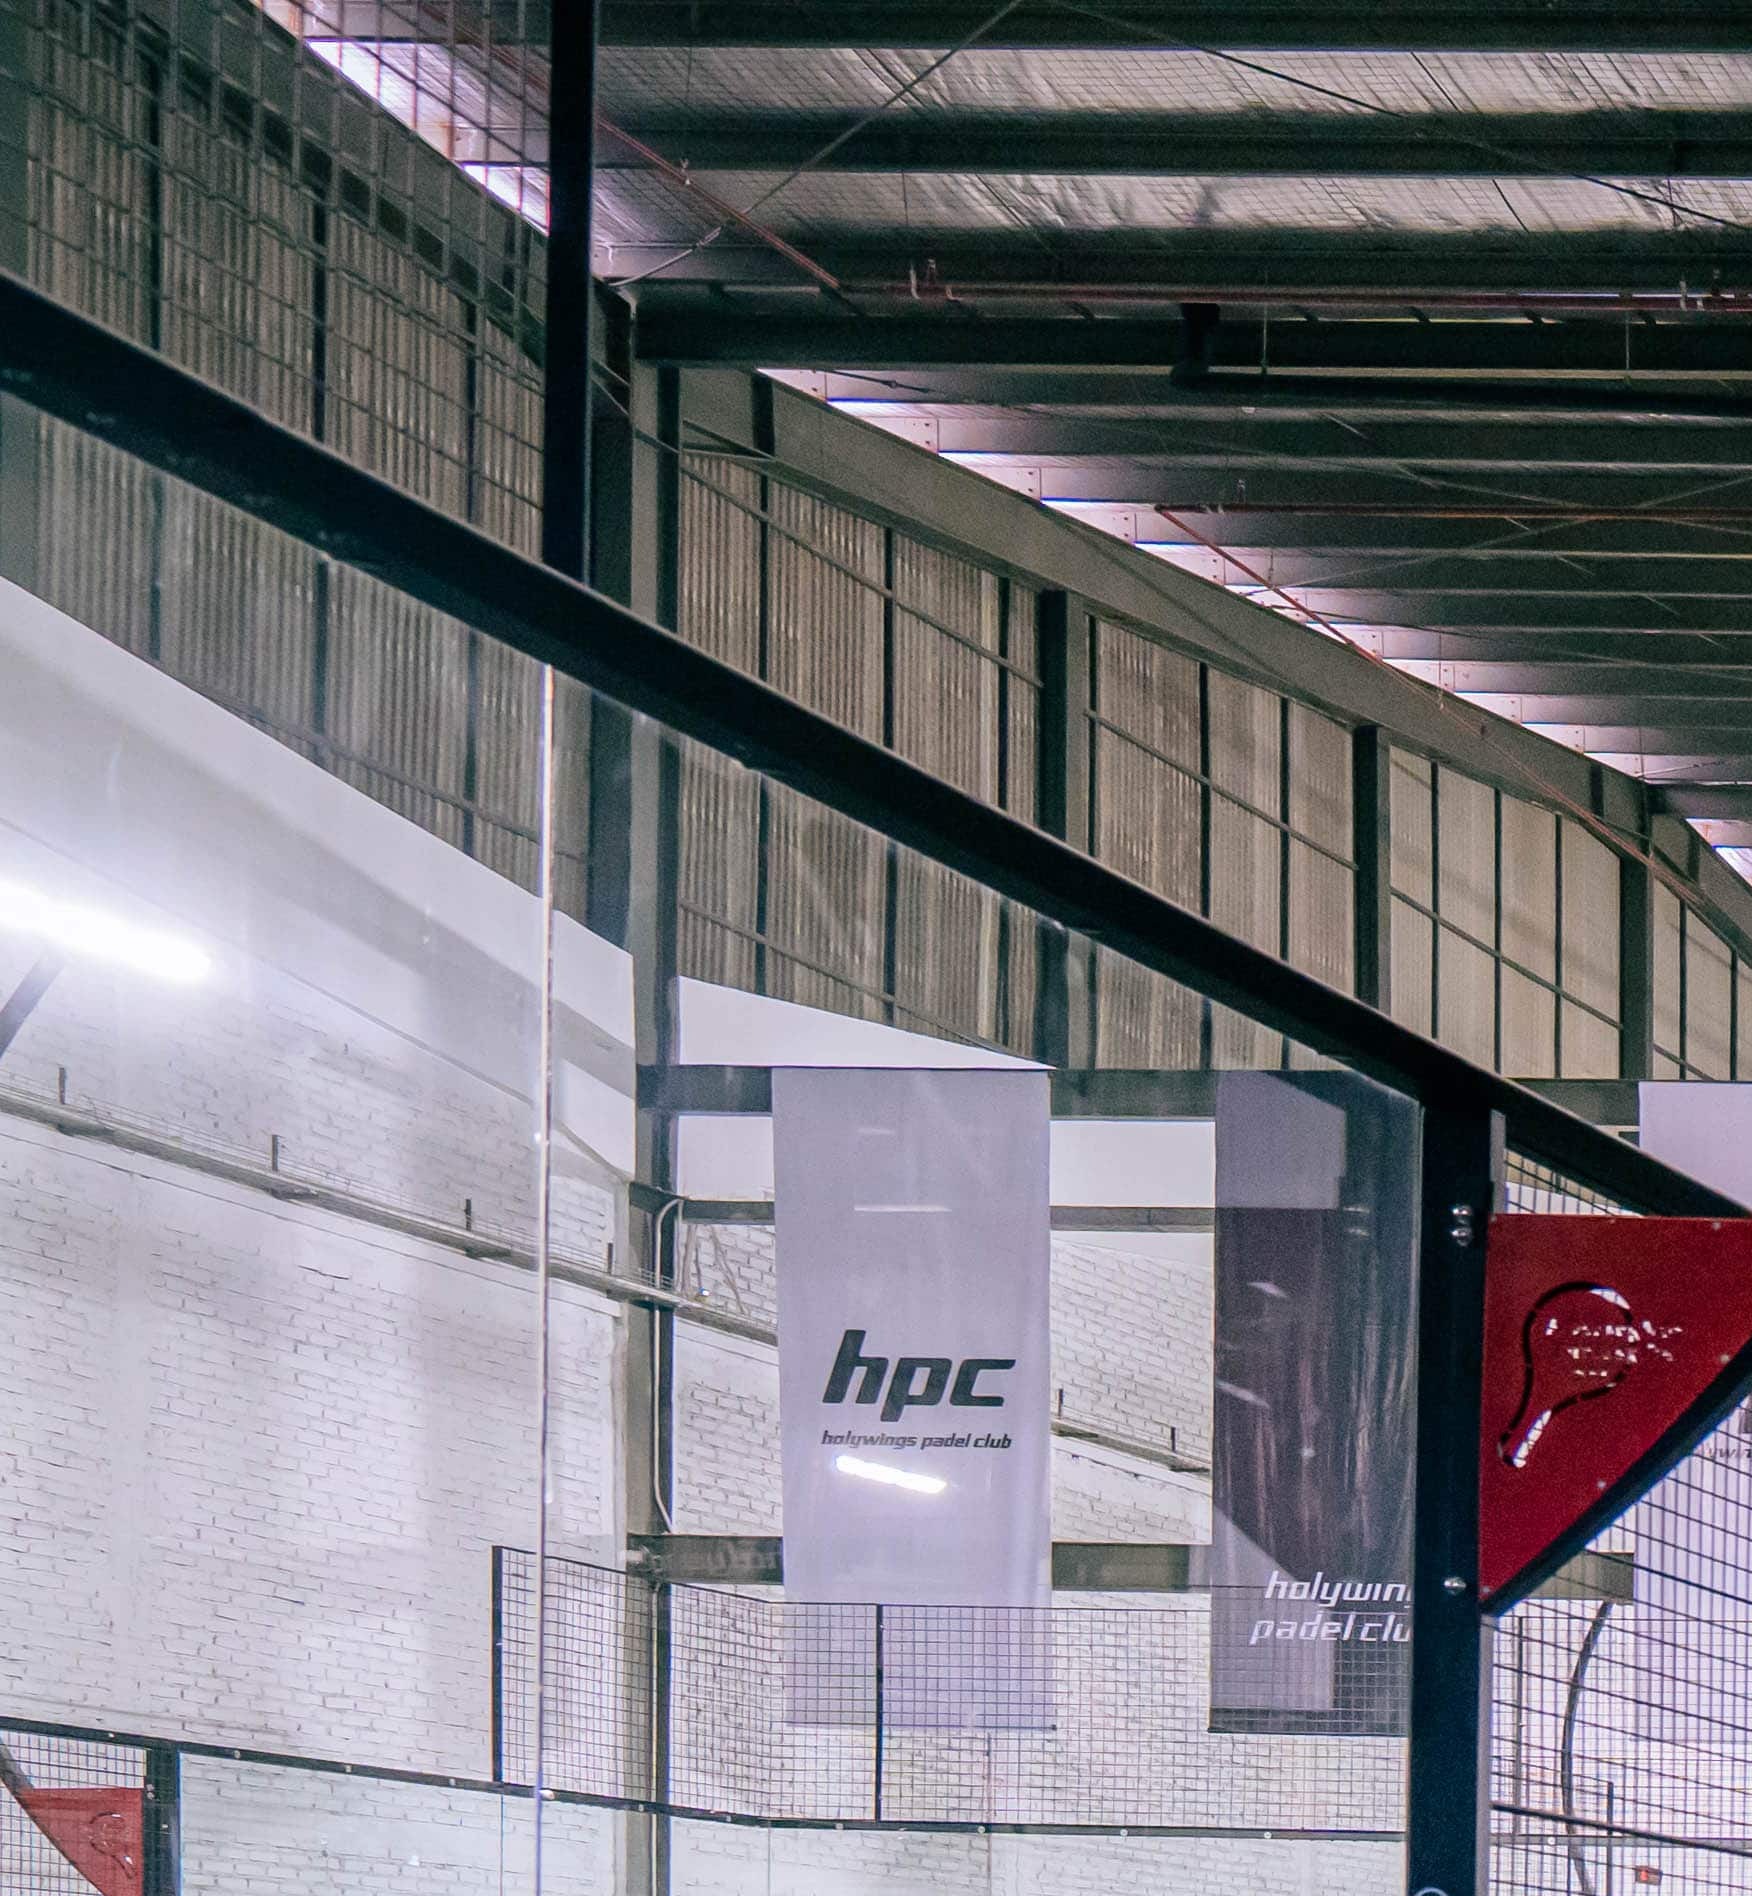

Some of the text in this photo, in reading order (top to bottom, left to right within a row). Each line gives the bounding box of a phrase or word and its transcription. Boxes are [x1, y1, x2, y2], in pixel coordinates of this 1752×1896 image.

[822, 1329, 1016, 1422] hpc
[821, 1430, 1012, 1450] holywings padel club
[1264, 1570, 1412, 1608] holywin
[1250, 1611, 1412, 1646] padel clu
